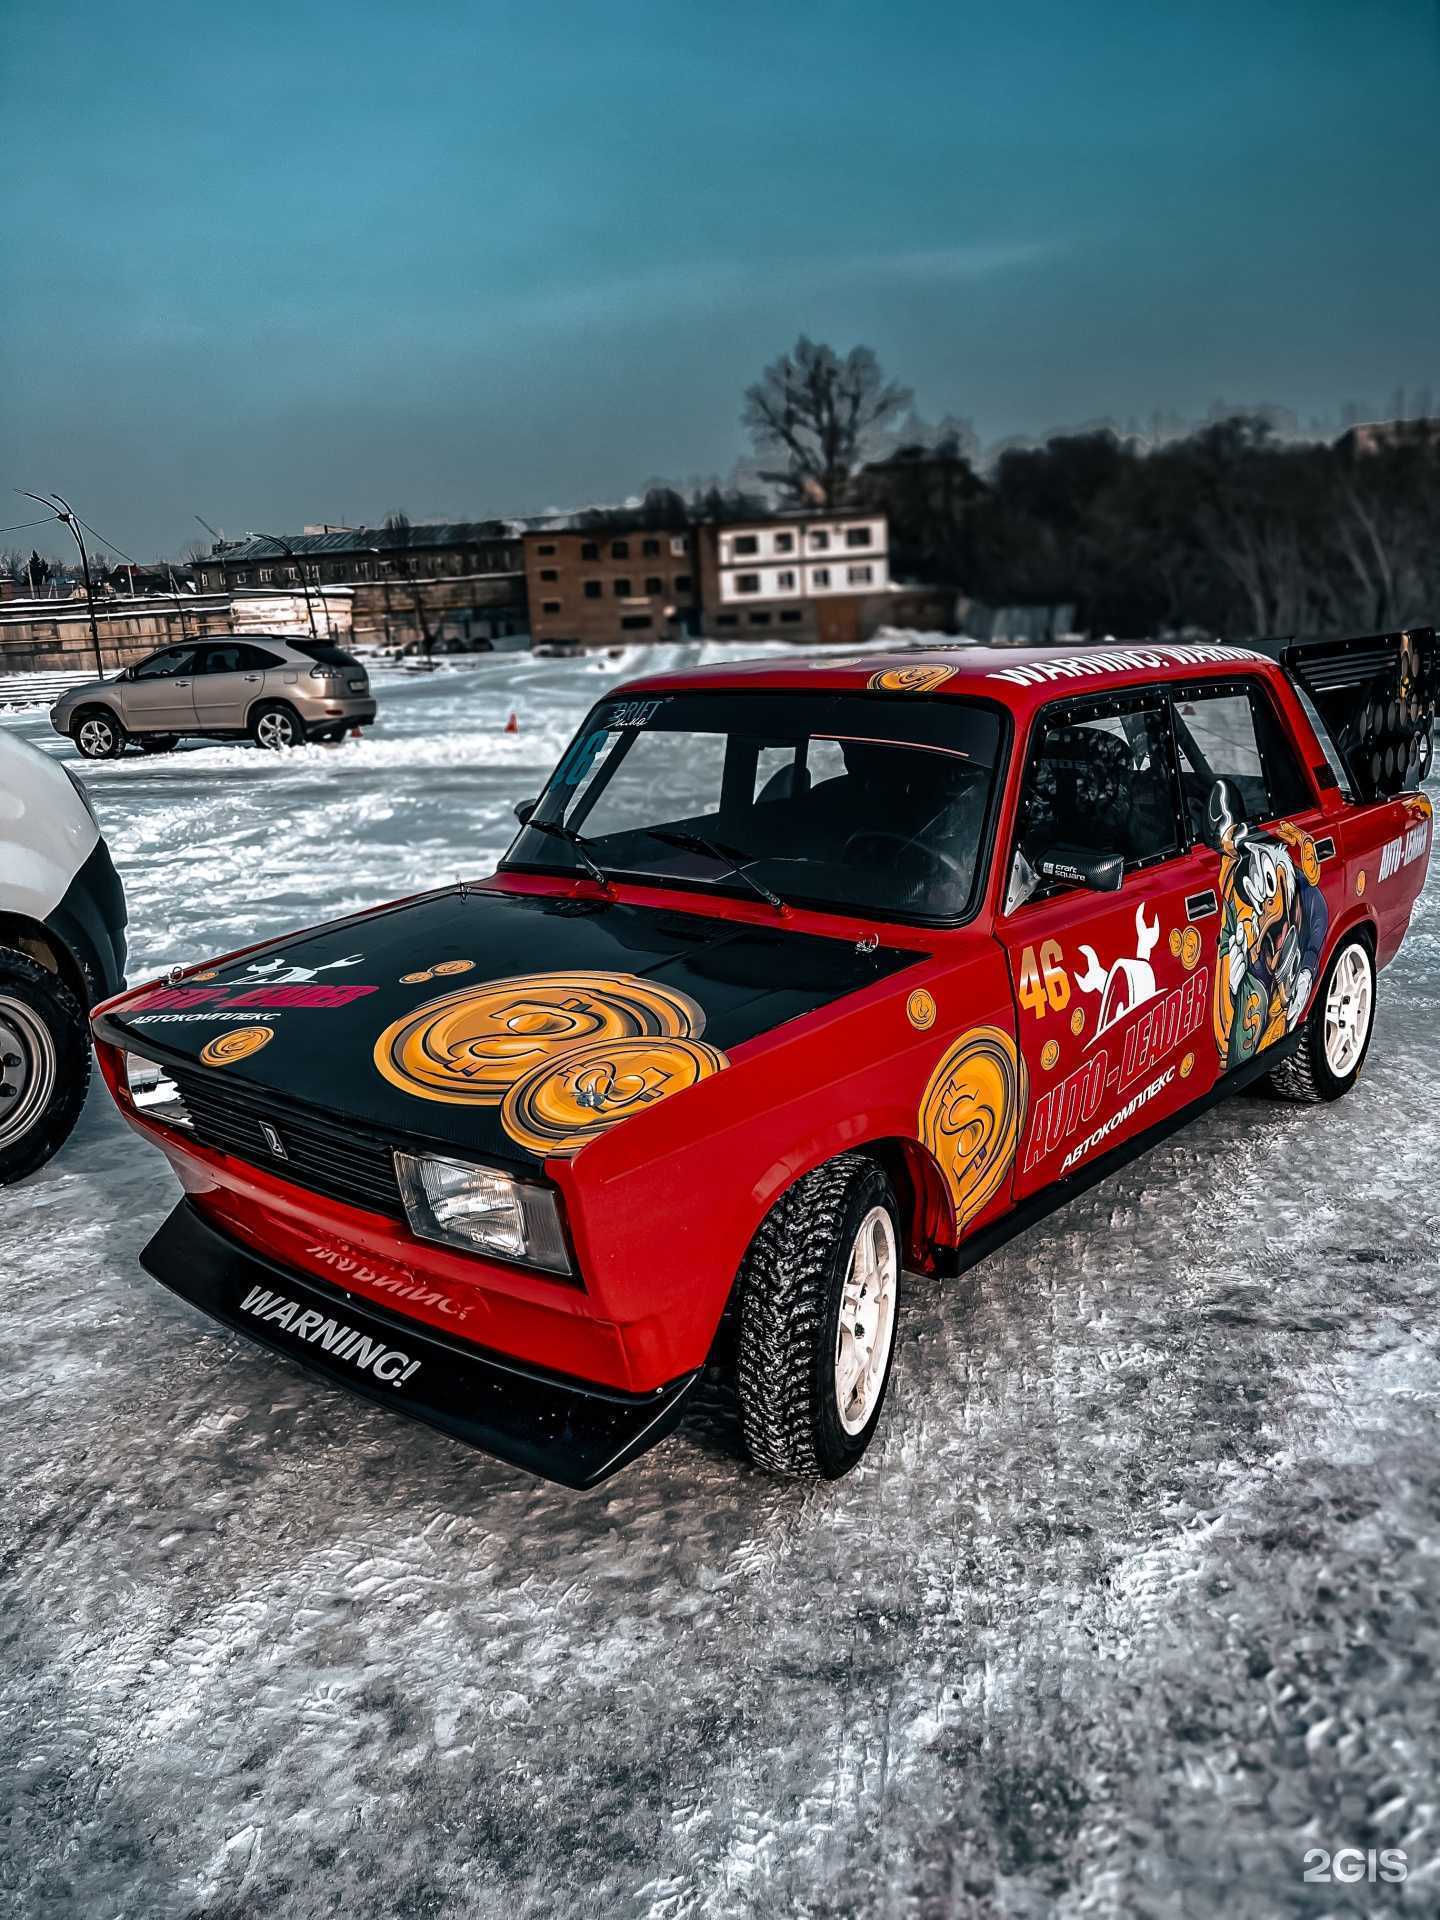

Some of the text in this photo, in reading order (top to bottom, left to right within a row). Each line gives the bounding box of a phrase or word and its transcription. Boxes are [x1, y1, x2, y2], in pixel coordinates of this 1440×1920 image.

[1055, 870, 1086, 882] square
[1018, 938, 1071, 1020] 46
[1023, 966, 1209, 1173] AUTO-LEADER
[1060, 1065, 1176, 1174] АВТОКОМПЛЕКС
[239, 1285, 422, 1388] WARNING!
